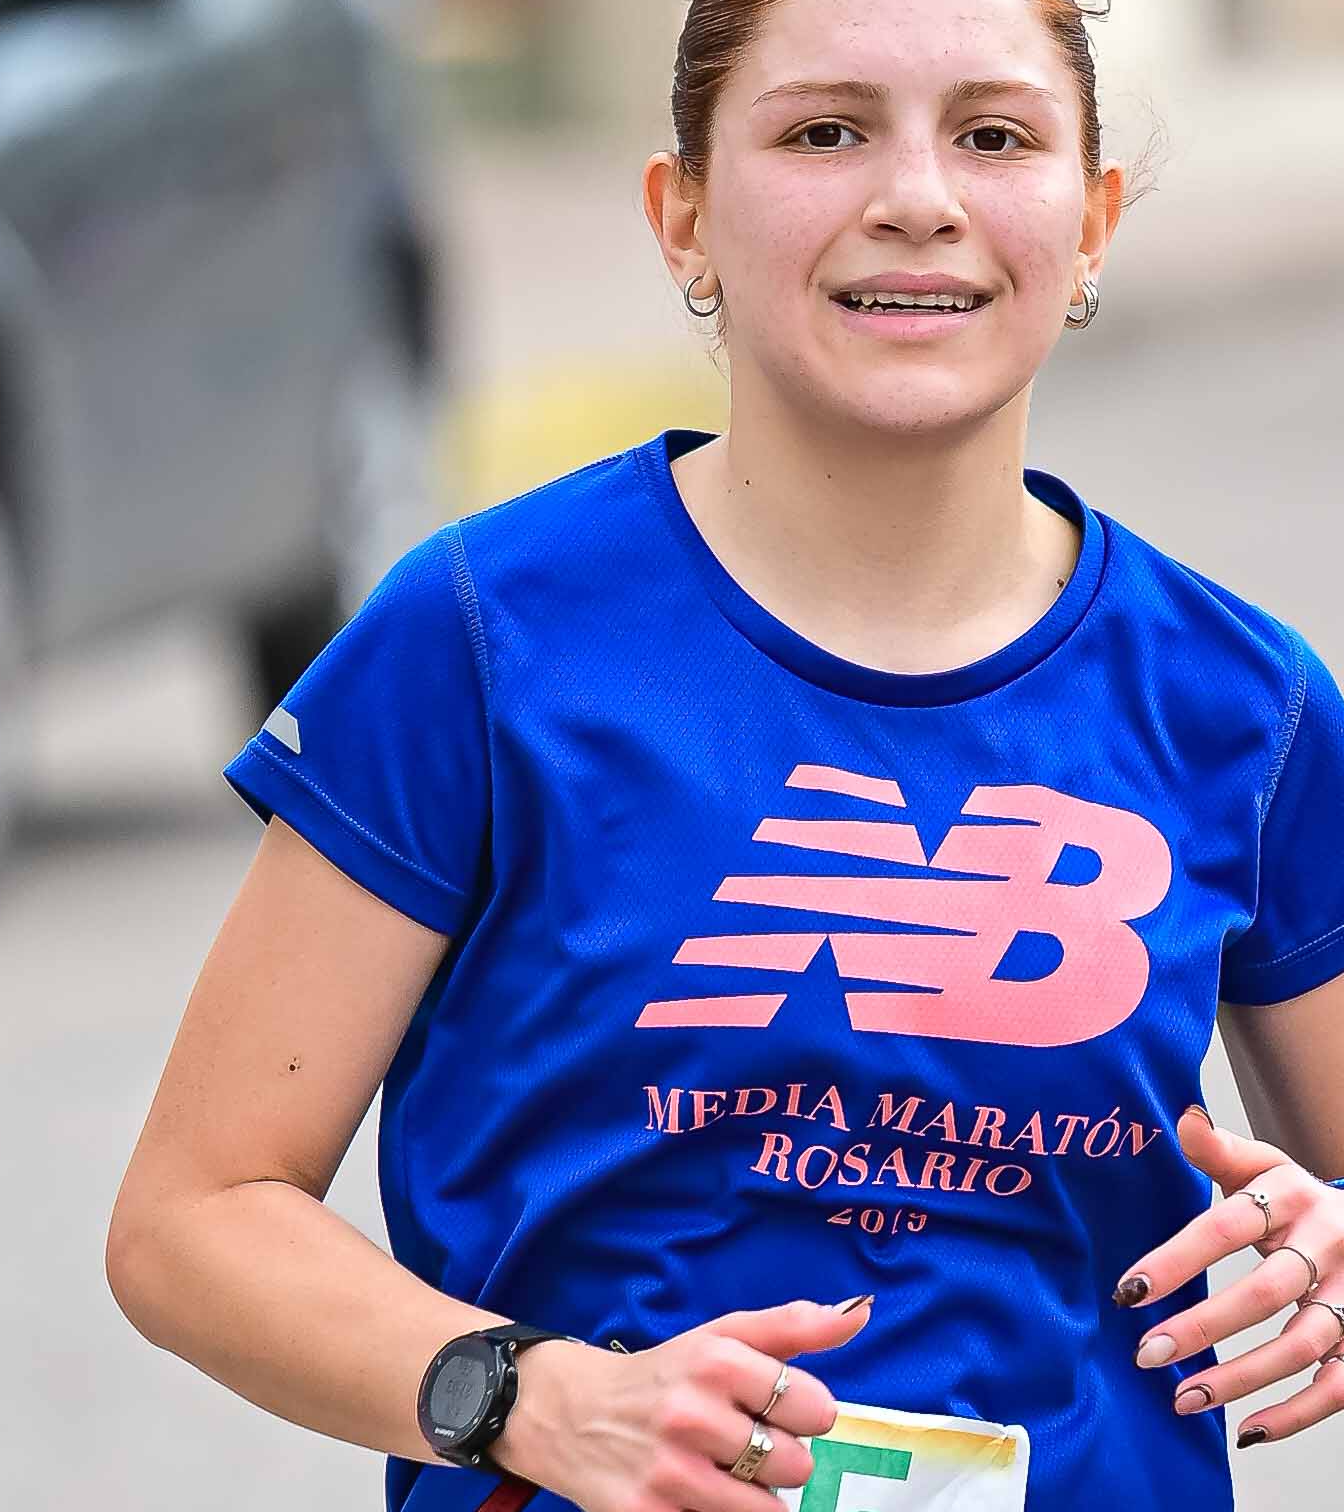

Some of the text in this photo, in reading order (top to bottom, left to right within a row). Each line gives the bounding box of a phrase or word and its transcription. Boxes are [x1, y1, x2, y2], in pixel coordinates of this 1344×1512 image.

[642, 1083, 1162, 1158] MEDIA MARATÓN
[750, 1131, 1032, 1197] ROSARIO
